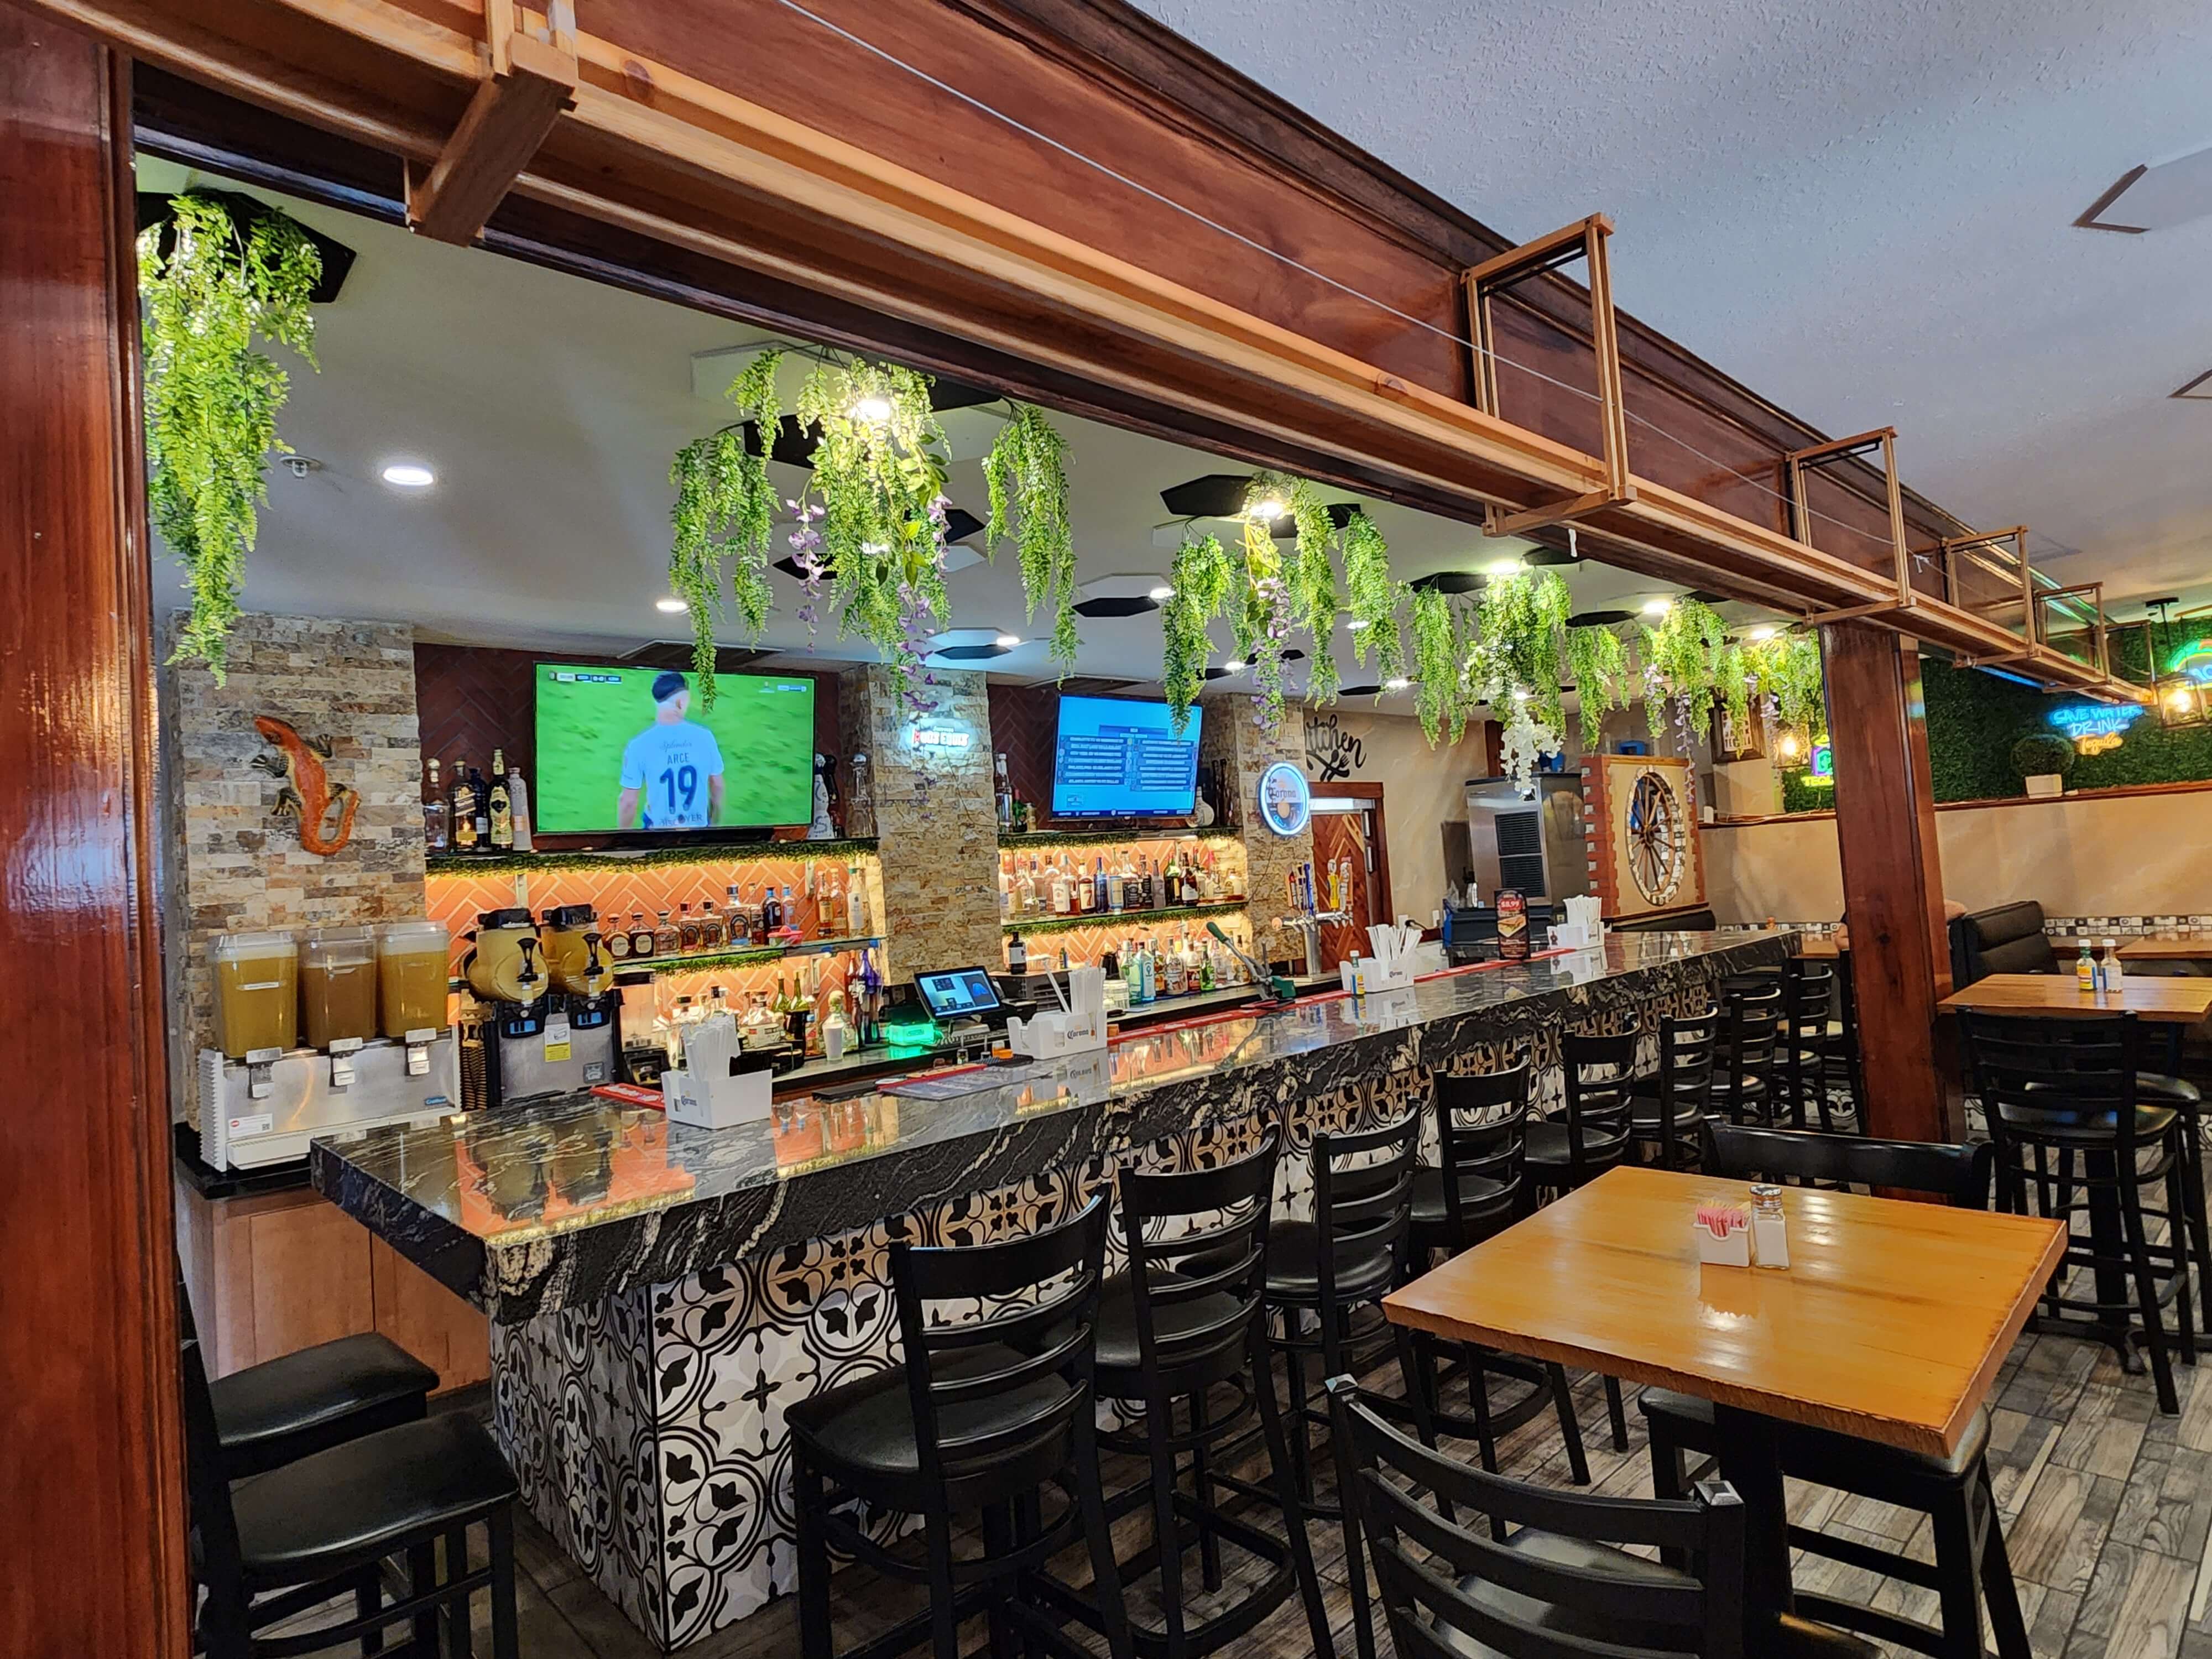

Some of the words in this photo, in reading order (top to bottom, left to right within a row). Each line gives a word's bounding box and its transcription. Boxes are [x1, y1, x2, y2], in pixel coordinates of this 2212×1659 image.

[2053, 708, 2089, 724] SAVE
[2067, 718, 2130, 737] DRINK
[1306, 713, 1367, 769] itchen
[2075, 733, 2123, 755] Tequila
[667, 753, 690, 765] ARCE
[660, 765, 697, 814] 19
[1268, 787, 1297, 800] Corona
[1067, 1030, 1089, 1040] Corona
